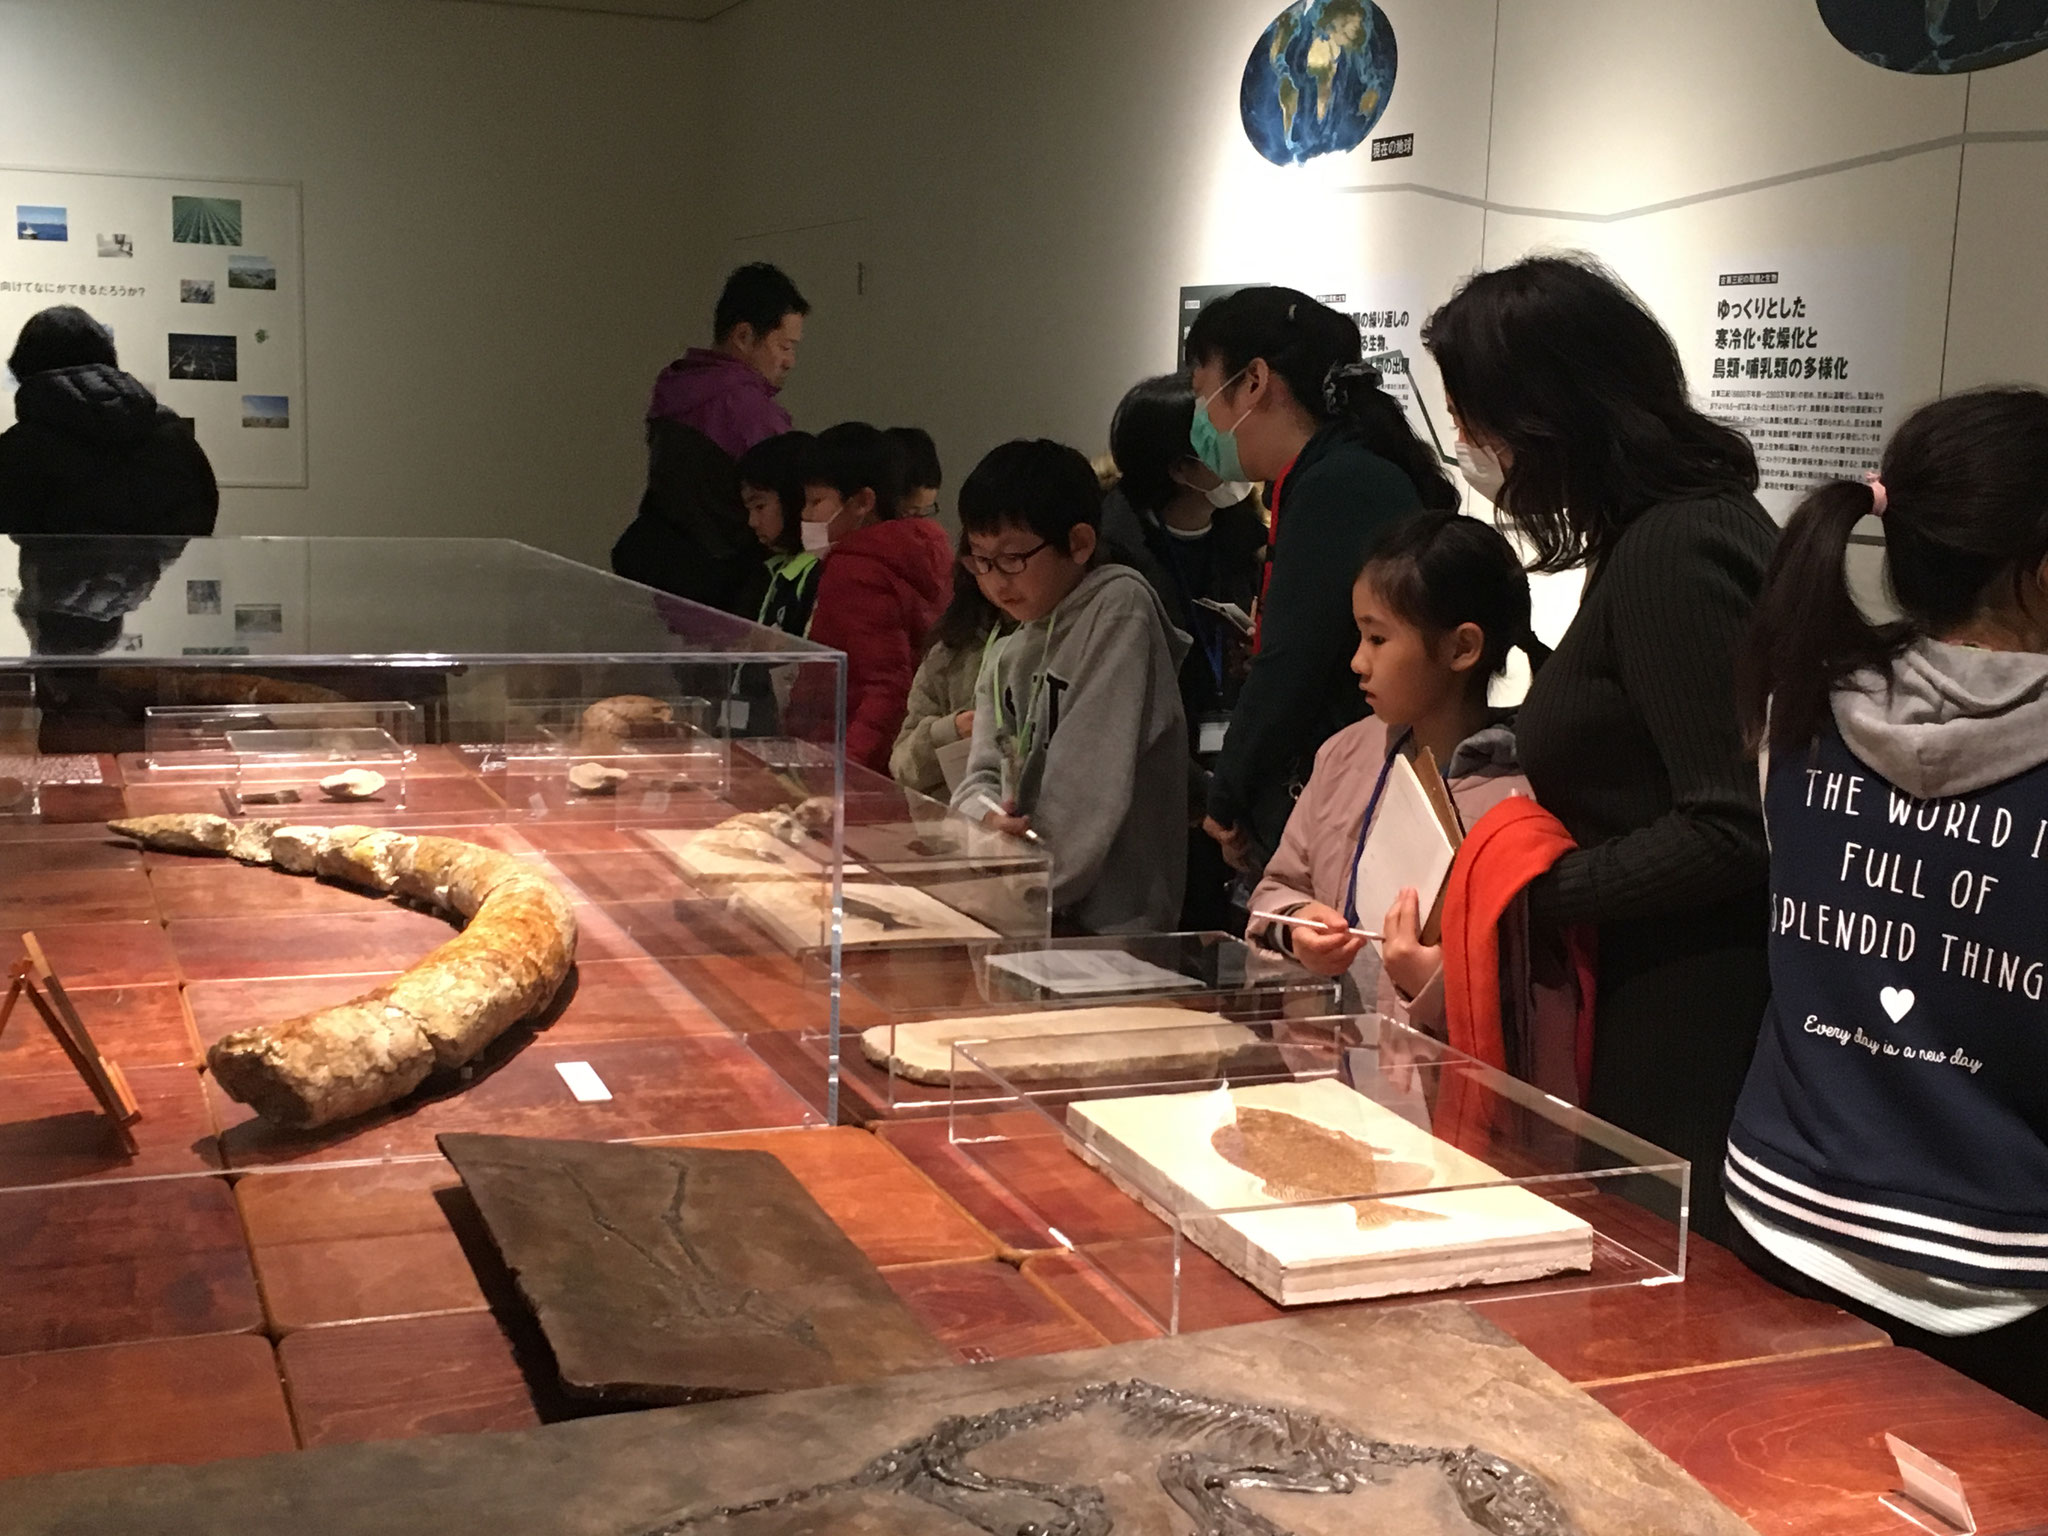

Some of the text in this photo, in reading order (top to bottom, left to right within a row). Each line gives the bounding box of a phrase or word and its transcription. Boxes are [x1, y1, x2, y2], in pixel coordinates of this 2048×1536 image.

[1372, 136, 1413, 159] 現在の地球
[1717, 296, 1806, 320] ゆっくりとした
[1715, 326, 1818, 350] 寒冷化・乾燥化と
[1712, 356, 1848, 380] 鳥類・哺乳類の多様化
[1806, 769, 1864, 815] THE
[1888, 786, 2012, 848] WORLD
[1840, 842, 1998, 914] FULL OF
[1942, 933, 2043, 1000] THING
[1804, 1014, 1983, 1074] Every day is a new day
